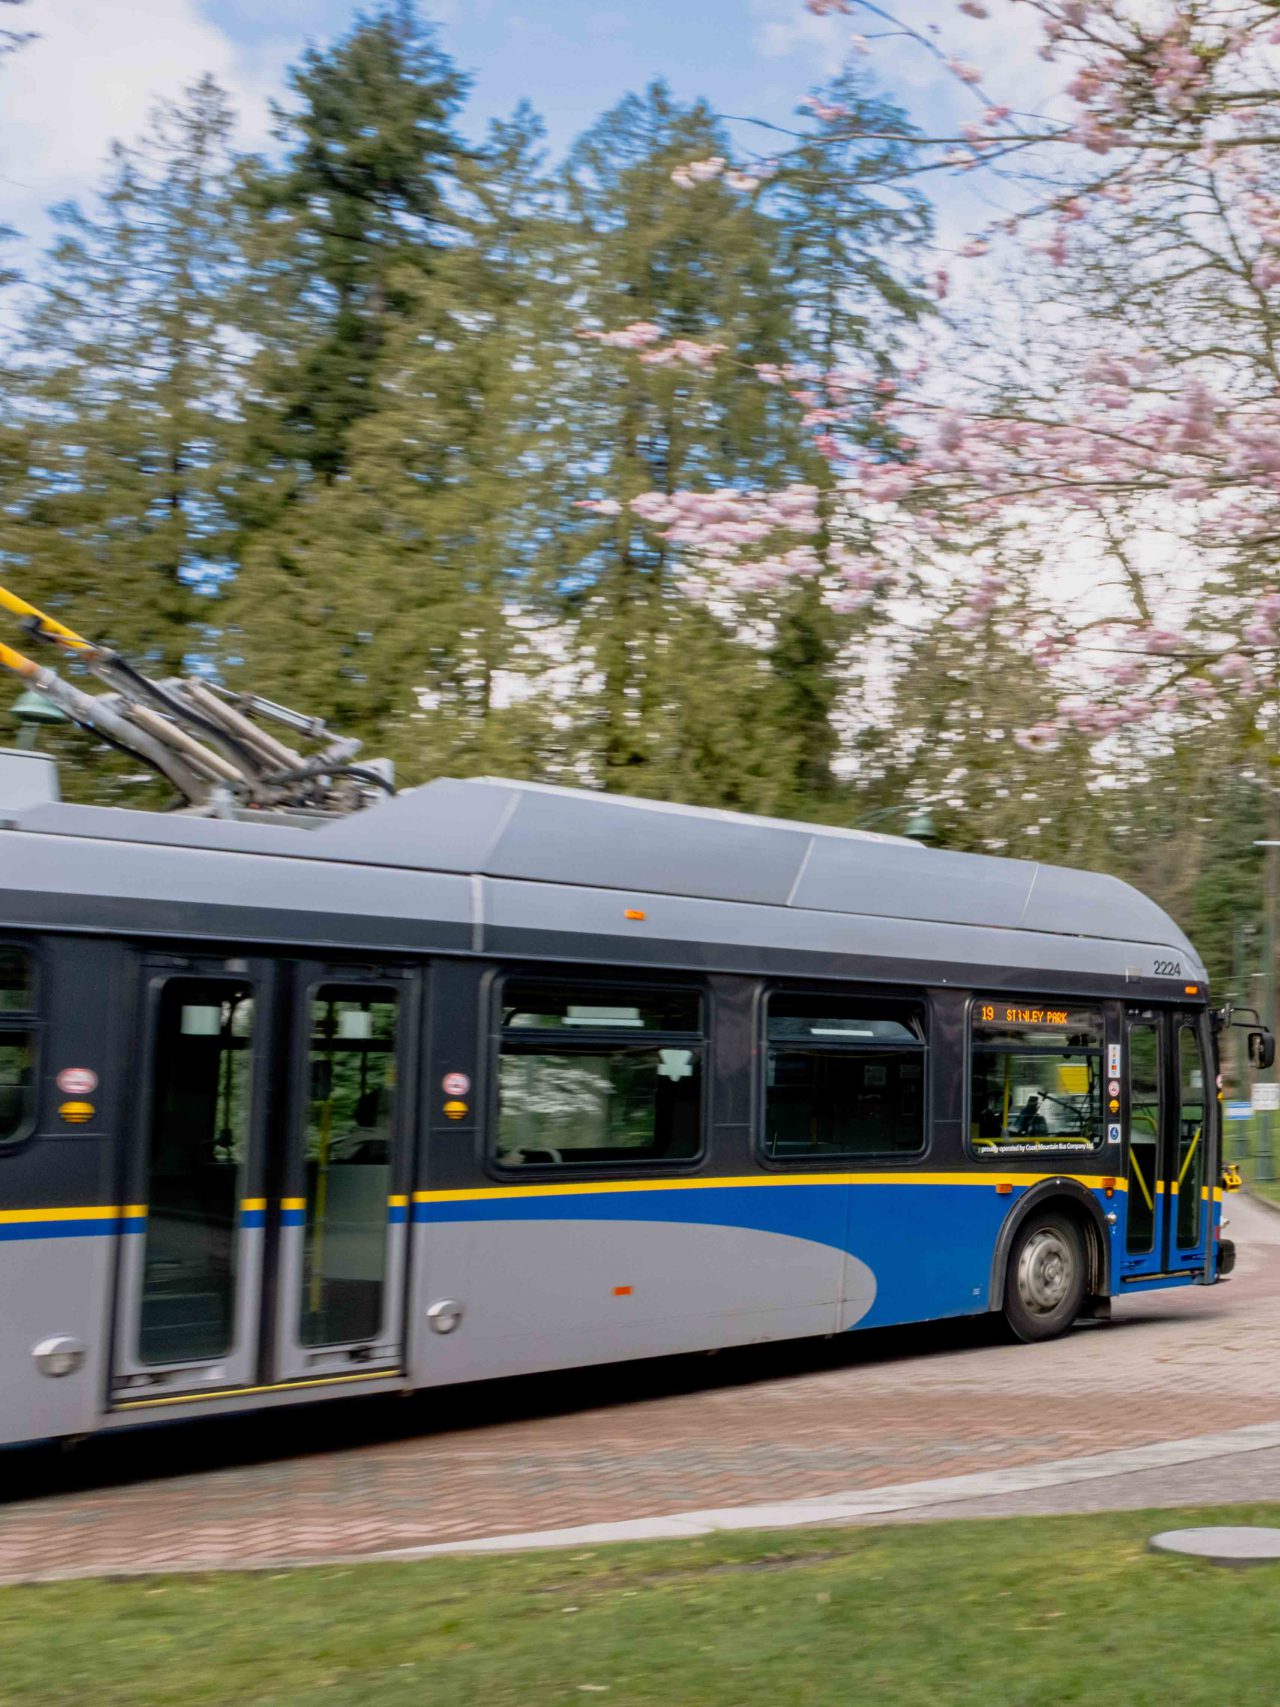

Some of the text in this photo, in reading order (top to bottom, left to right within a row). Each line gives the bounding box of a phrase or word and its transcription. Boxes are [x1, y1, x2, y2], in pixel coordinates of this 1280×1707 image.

[1153, 960, 1181, 976] 2224
[982, 1006, 995, 1020] 19
[1046, 1011, 1068, 1024] PARK
[999, 1144, 1020, 1153] operated
[1020, 1144, 1026, 1152] by
[1067, 1142, 1086, 1150] Company
